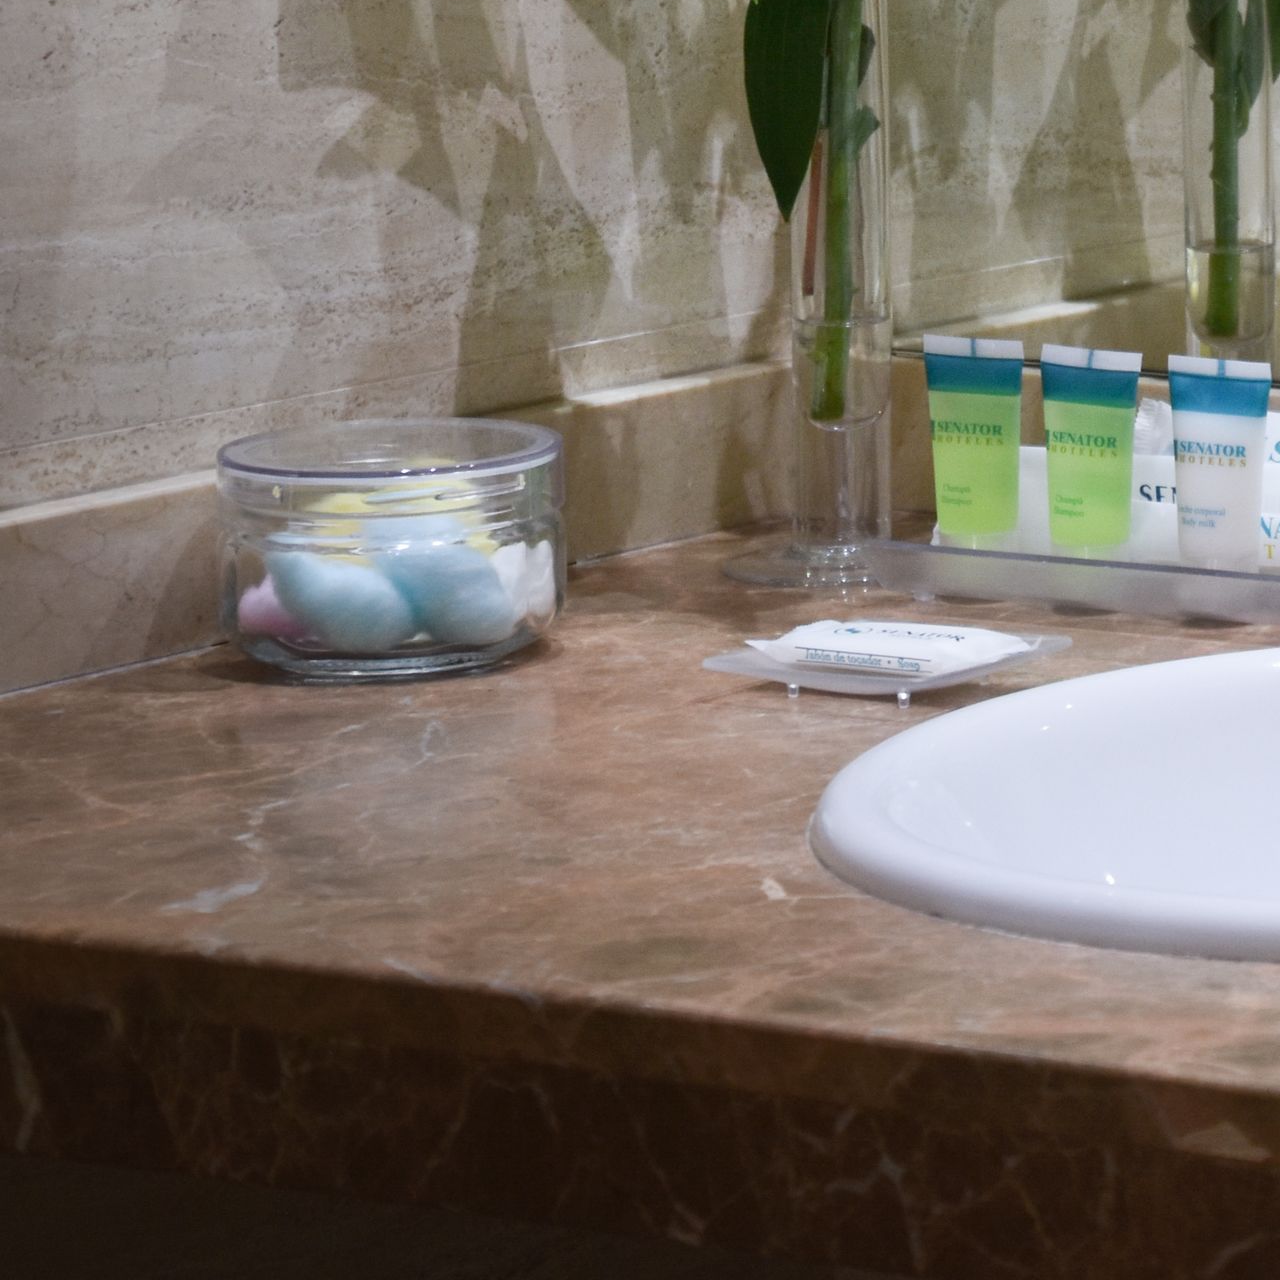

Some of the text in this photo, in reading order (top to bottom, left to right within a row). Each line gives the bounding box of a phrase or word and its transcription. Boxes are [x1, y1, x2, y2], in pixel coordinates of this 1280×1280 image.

[937, 421, 1003, 436] SENATOR
[936, 434, 1004, 447] HOTELES
[1052, 431, 1118, 449] SENATOR
[1051, 443, 1118, 458] HOTELES
[1180, 440, 1247, 458] SENATOR
[1179, 454, 1247, 468] HOTELES
